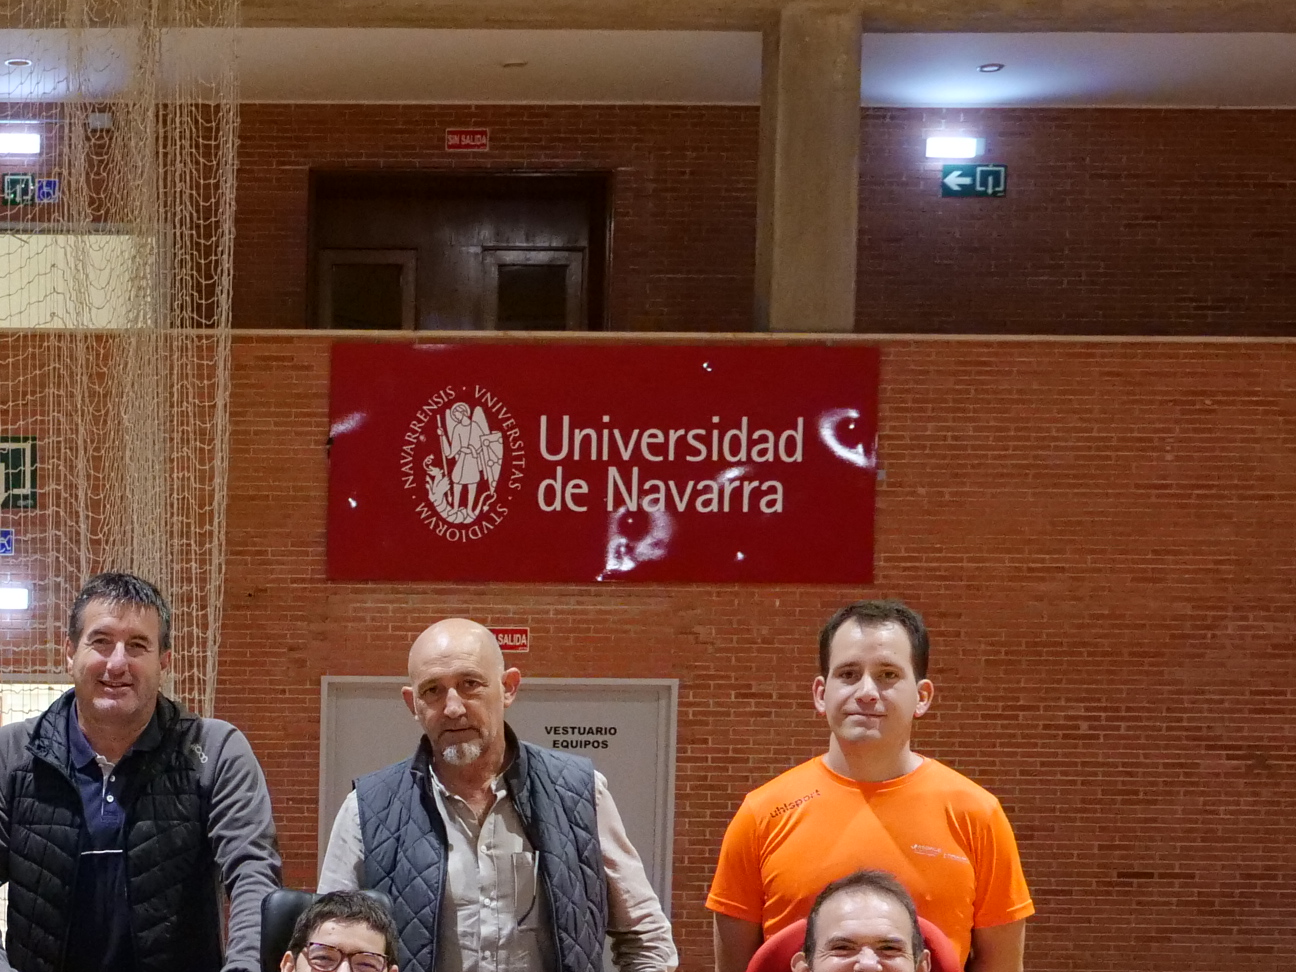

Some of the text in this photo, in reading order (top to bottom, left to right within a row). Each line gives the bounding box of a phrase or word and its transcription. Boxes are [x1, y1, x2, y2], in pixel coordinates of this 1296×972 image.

[461, 134, 486, 145] SALIDA
[400, 385, 456, 490] NAVARRENSIS
[474, 384, 526, 491] VNIVERSITAS
[538, 414, 804, 463] Universidad
[537, 466, 785, 514] de Navarra
[415, 501, 508, 543] STVDIORVM
[497, 633, 527, 646] SALIDA
[544, 726, 618, 736] VESTUARIO
[552, 739, 609, 749] EQUIPOS
[769, 789, 821, 818] uhlsport
